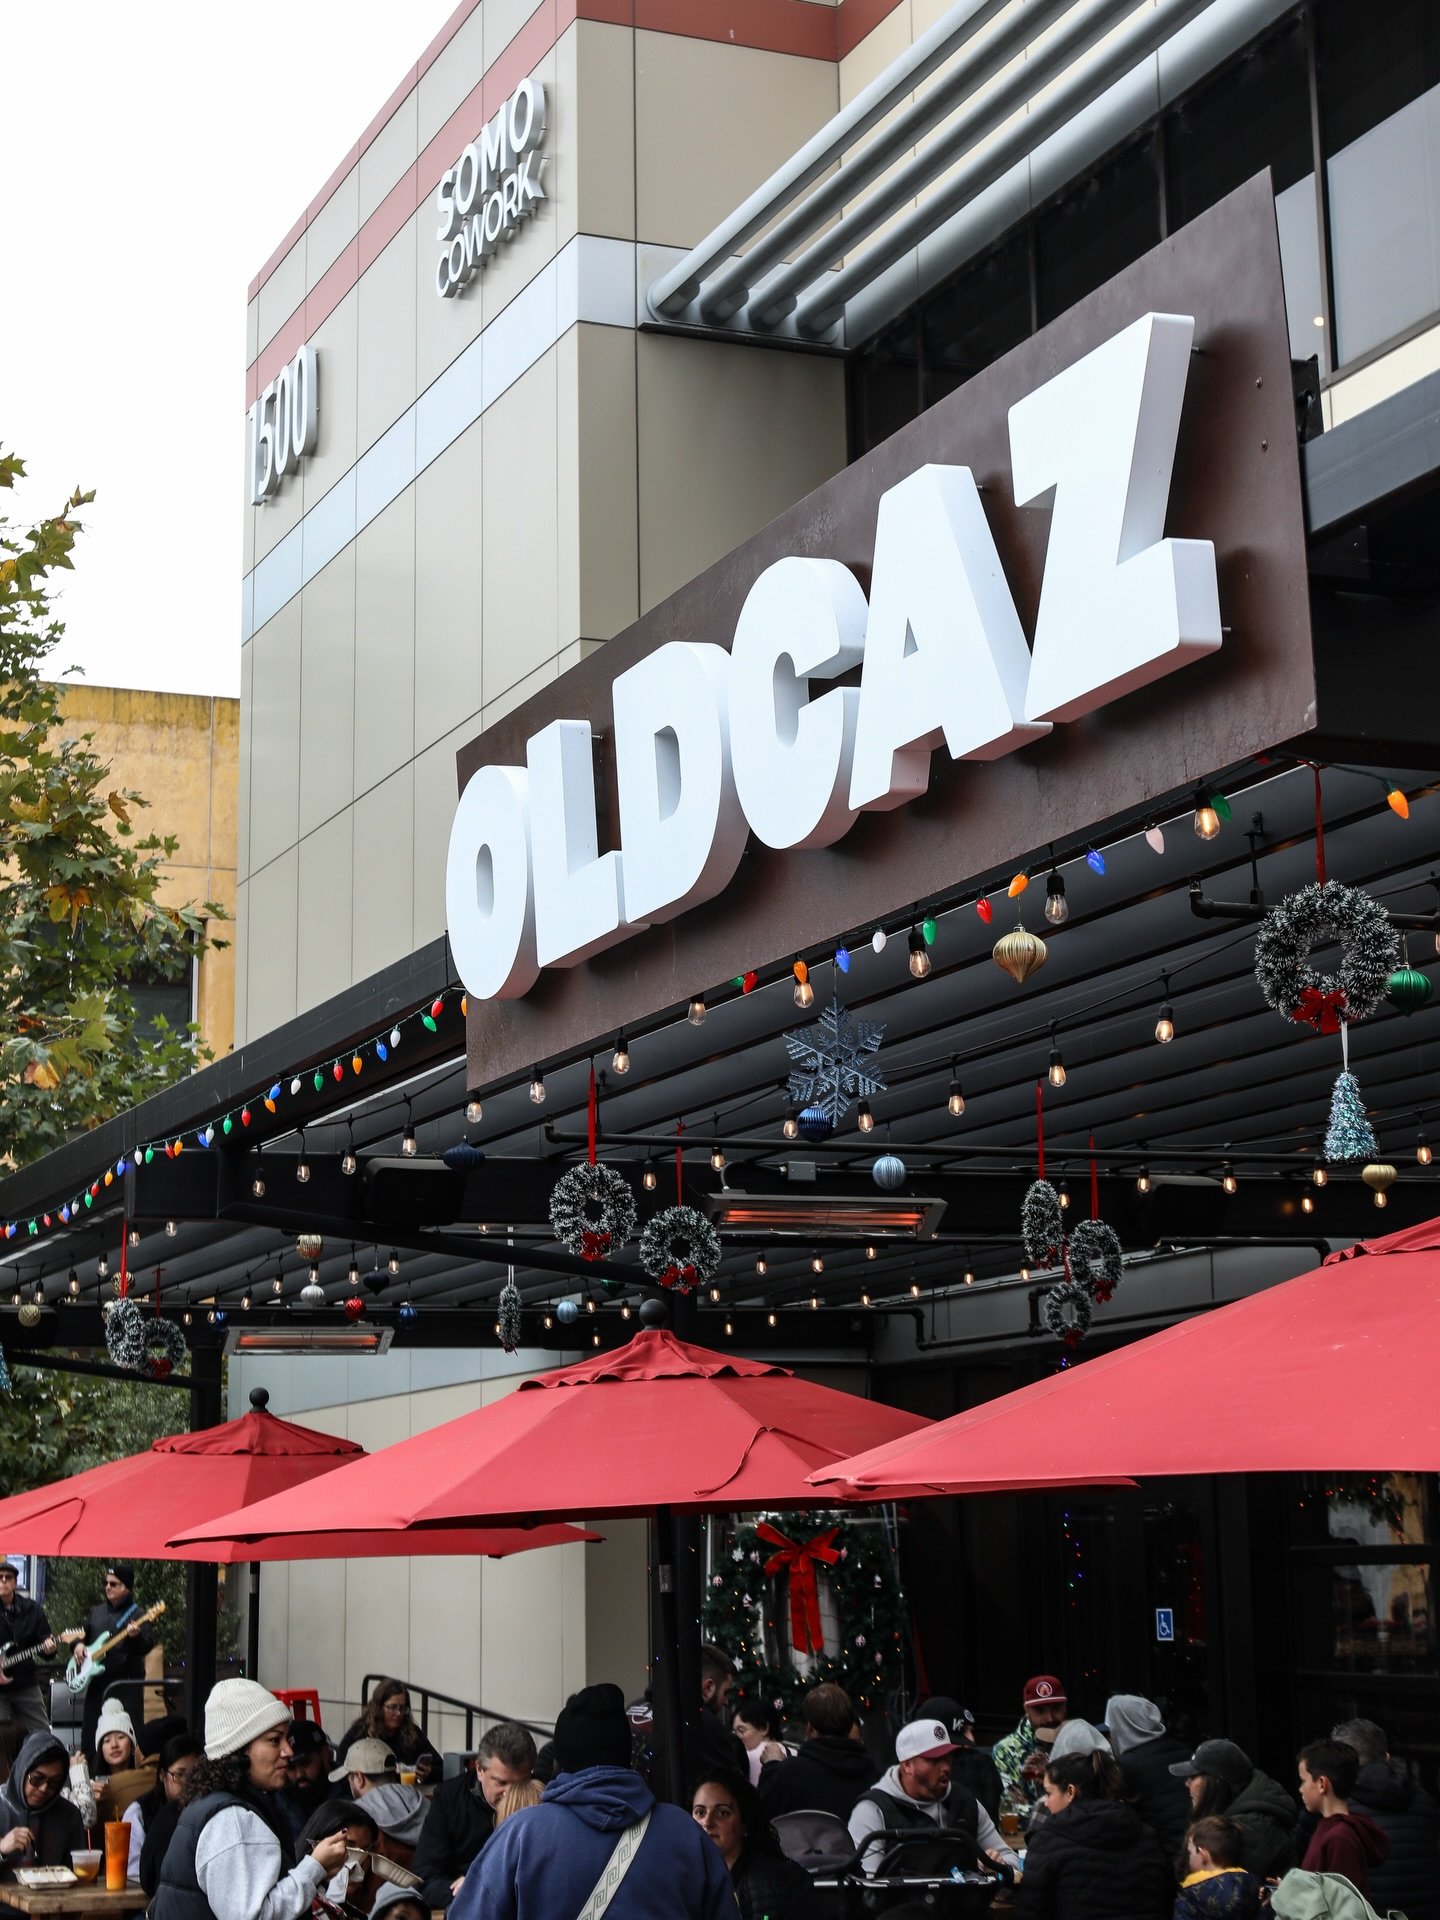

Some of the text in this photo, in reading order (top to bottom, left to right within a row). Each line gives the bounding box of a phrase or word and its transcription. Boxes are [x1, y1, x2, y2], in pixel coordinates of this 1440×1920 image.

[436, 78, 544, 241] SOMO
[436, 150, 545, 298] COWORK
[250, 344, 317, 506] 1500
